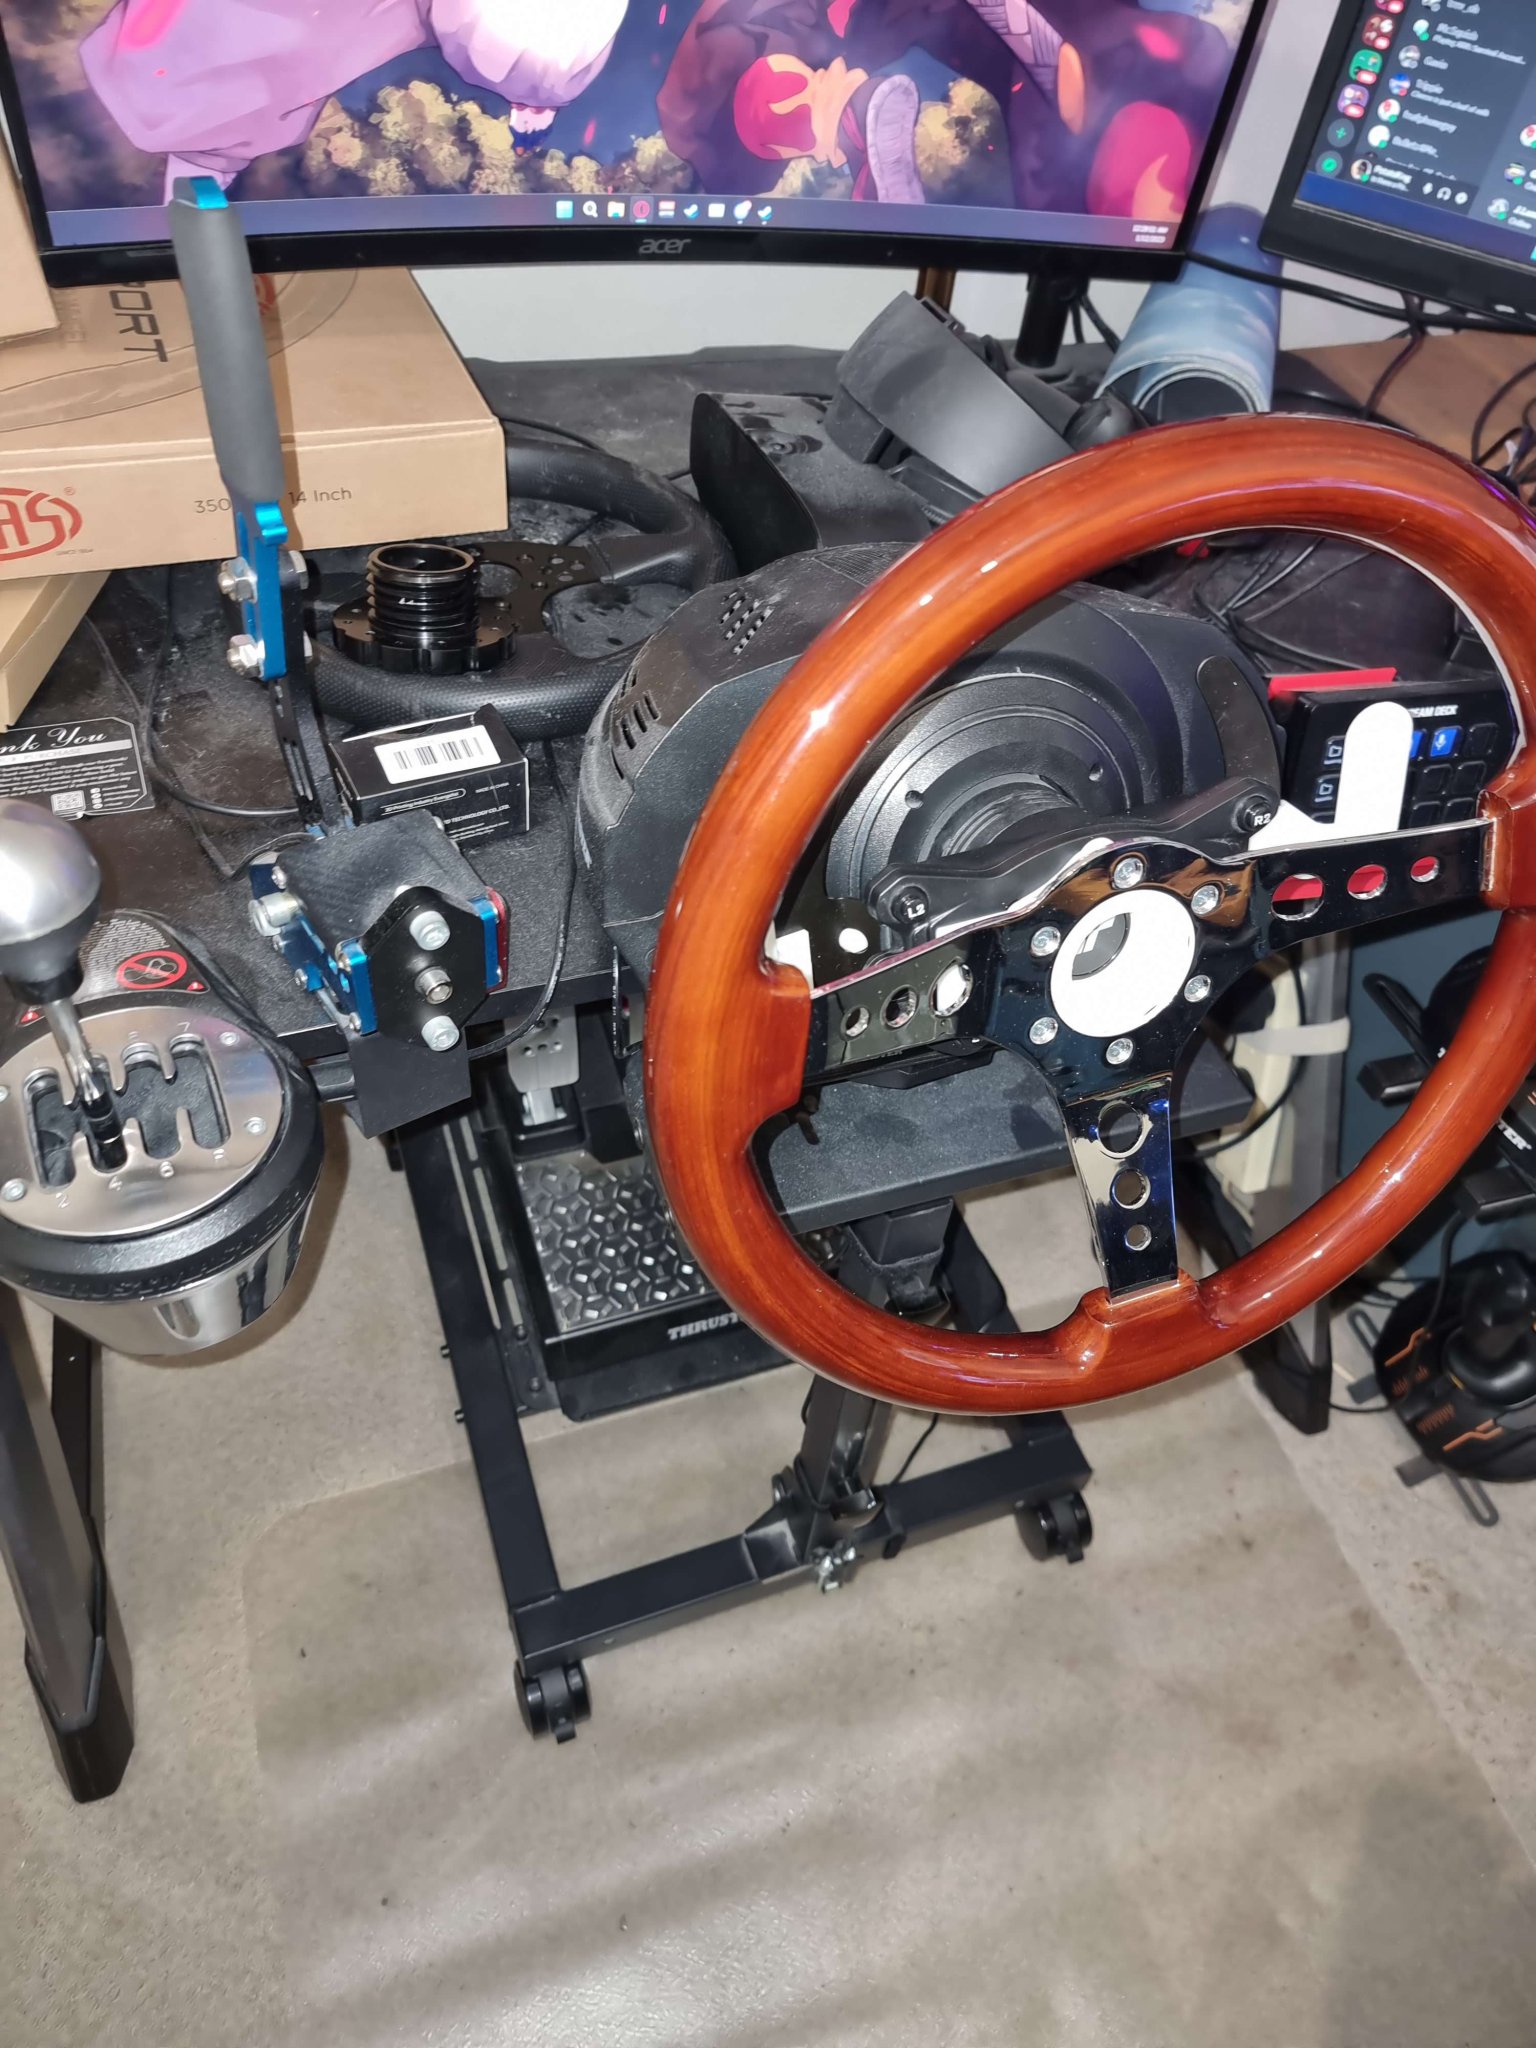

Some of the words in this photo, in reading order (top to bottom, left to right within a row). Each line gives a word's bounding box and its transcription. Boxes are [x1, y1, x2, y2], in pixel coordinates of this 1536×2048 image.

[639, 239, 692, 254] acer
[313, 487, 352, 503] Inch
[47, 727, 107, 748] You
[1254, 812, 1271, 826] R2
[907, 903, 925, 919] L2
